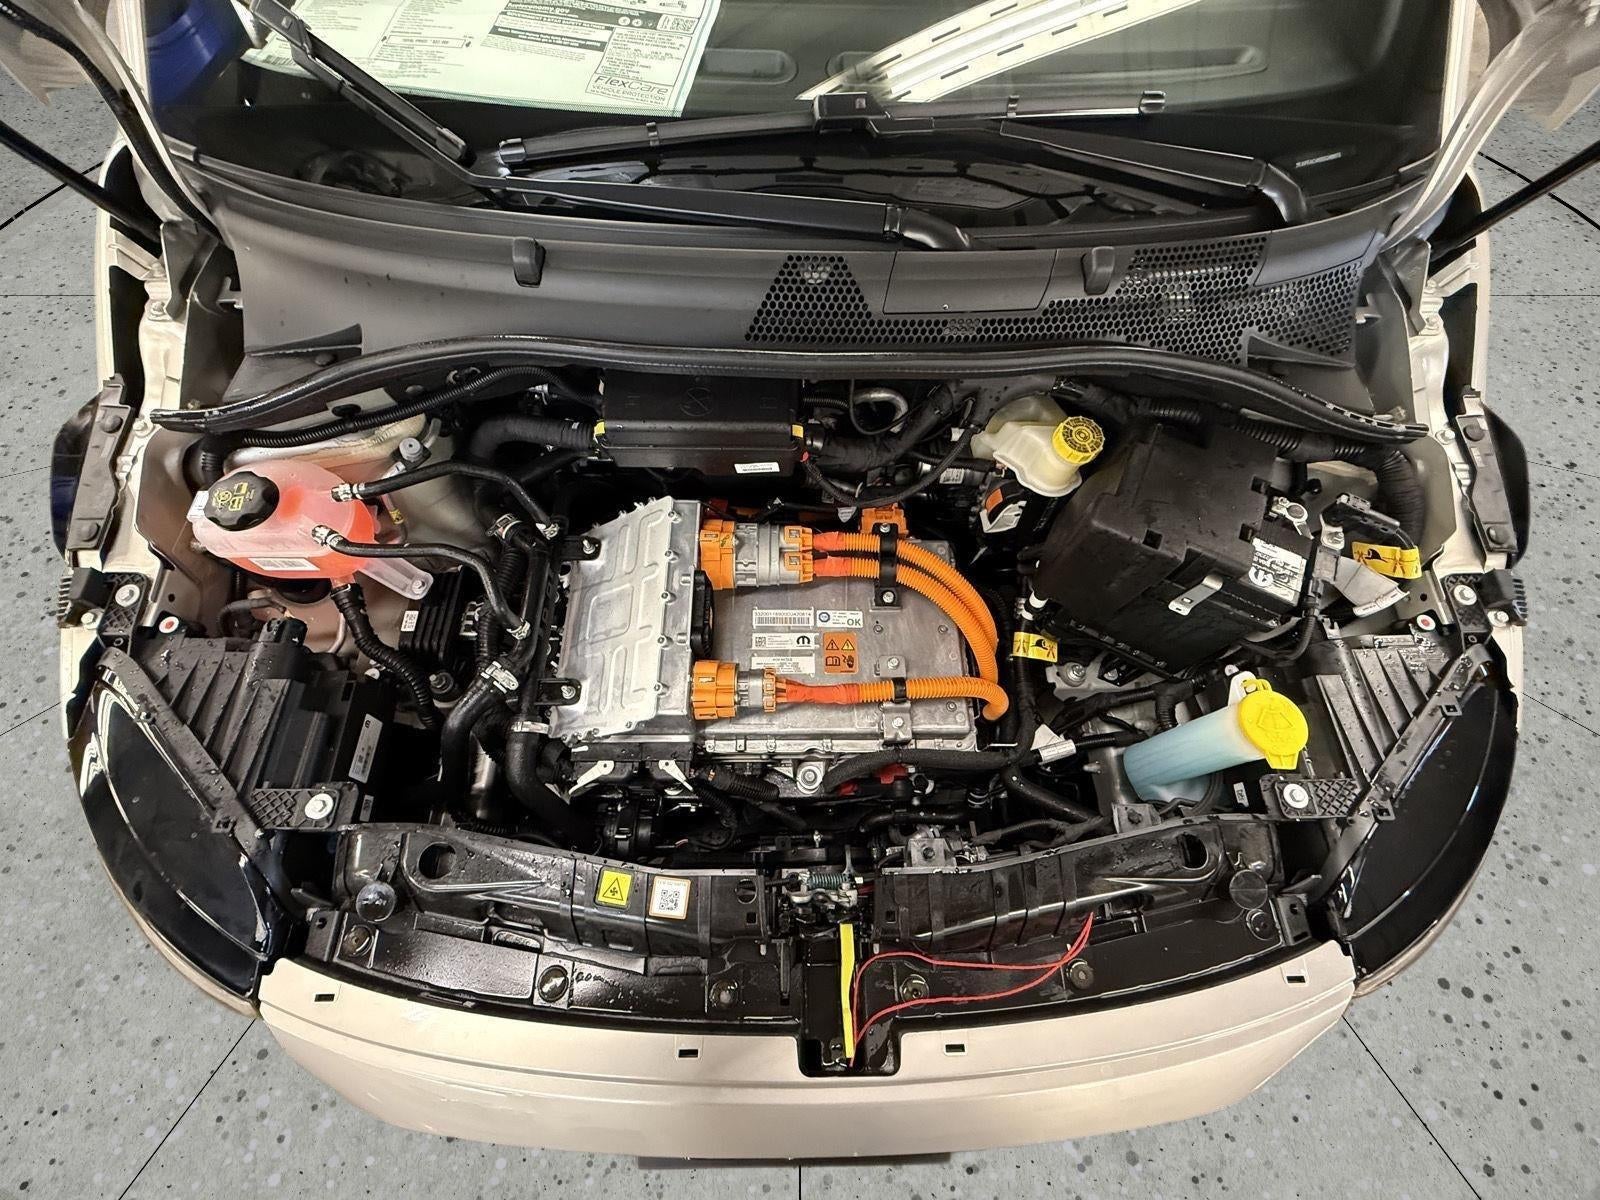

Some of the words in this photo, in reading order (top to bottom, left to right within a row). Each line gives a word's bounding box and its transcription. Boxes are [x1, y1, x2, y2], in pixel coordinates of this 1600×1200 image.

[592, 84, 620, 95] VEHICLE
[621, 88, 666, 102] PROTECTION
[594, 75, 669, 96] FlexCare
[846, 618, 862, 626] OK
